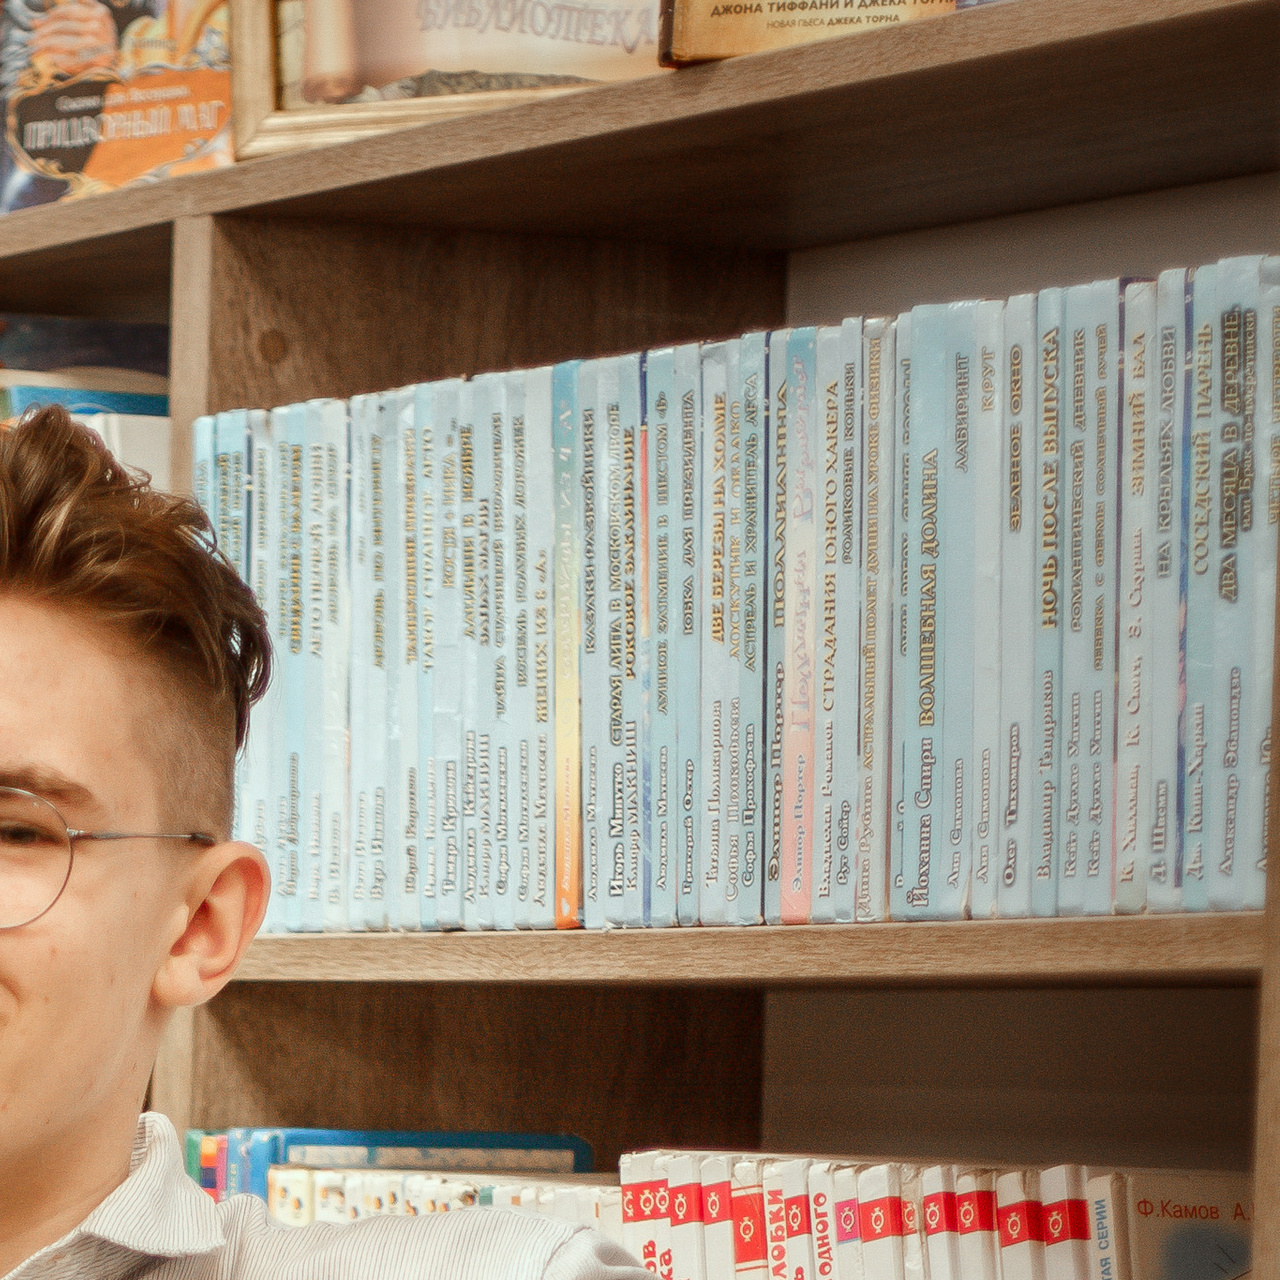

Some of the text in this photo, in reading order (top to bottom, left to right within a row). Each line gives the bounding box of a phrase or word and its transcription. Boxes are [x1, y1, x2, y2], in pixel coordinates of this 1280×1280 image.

[711, 4, 763, 17] ДЖОНА
[766, 13, 900, 30] НОВАЯ ДЖЕКА ТОРНА
[623, 426, 638, 826] МАКНИШ РОКОВОЕ ЗАКЛИНАНИЕ
[681, 388, 695, 895] Григорий Остер ЮБКА ДЛЯ ПРЕЗИДЕНТА
[704, 390, 726, 888] Татьяна Поликарпова ДВЕ БЕРЕЗЫ НА ХОЛМЕ
[743, 371, 758, 887] Софья Прокофьева АСТРЕЛЬ И ХРАНИТЕЛЬ ЛЕСА
[768, 379, 787, 881] Элинор Портер ПОЛЛИАННА
[822, 378, 838, 712] СТРАДАНИЯ ЮНОГО ХАКЕРА
[837, 361, 855, 885] Рут Сойер РОЛИКОВЫЕ КОНЬКИ
[859, 336, 881, 853] Рубина АСТРАЛЬНЫЙ ПОЛЕТ ДУШИ НА УРОКЕ ФИЗИКИ
[947, 352, 970, 888] Лия Симонова ЛАБИРИНТ
[975, 345, 995, 884] Лия Симонова КРУГ
[1001, 343, 1022, 887] Олег Тихомиров ЗЕЛЕНОЕ ОКНО
[1035, 326, 1059, 882] Владимир Тендряков НОЧЬ ПОСЛЕ ВЫПУСКА
[1064, 327, 1088, 879] Кейт Дуглас РОМАНТИЧЕСКИЙ ДНЕВНИК
[1087, 323, 1109, 878] Кейт Дуглас РЕБЕККА ФЕРМЫ СОЛНЕЧНЫЙ РУЧЕЙ
[1128, 327, 1146, 497] ЗИМНИЙ БАЛ
[1150, 326, 1176, 883] Д. Швемм НА КРЫЛЬЯХ ЛЮБВИ
[1192, 322, 1212, 576] СОСЕДСКИЙ ПАРЕНЬ
[1218, 304, 1241, 876] Александр ДВА МЕСЯЦА В ДЕРЕВНЕ,
[1238, 448, 1254, 532] или Брак
[609, 762, 625, 897] Игорь Минутко
[725, 696, 742, 902] Софья Прокофьева
[792, 753, 805, 893] Элинор Портер
[906, 448, 939, 908] Йоханна Спири ВОЛШЕБНАЯ ДОЛИНА
[812, 1191, 834, 1277] ОДНОГО
[1094, 1199, 1111, 1251] СЕРИИ
[1136, 1197, 1220, 1219] Ф.Камов
